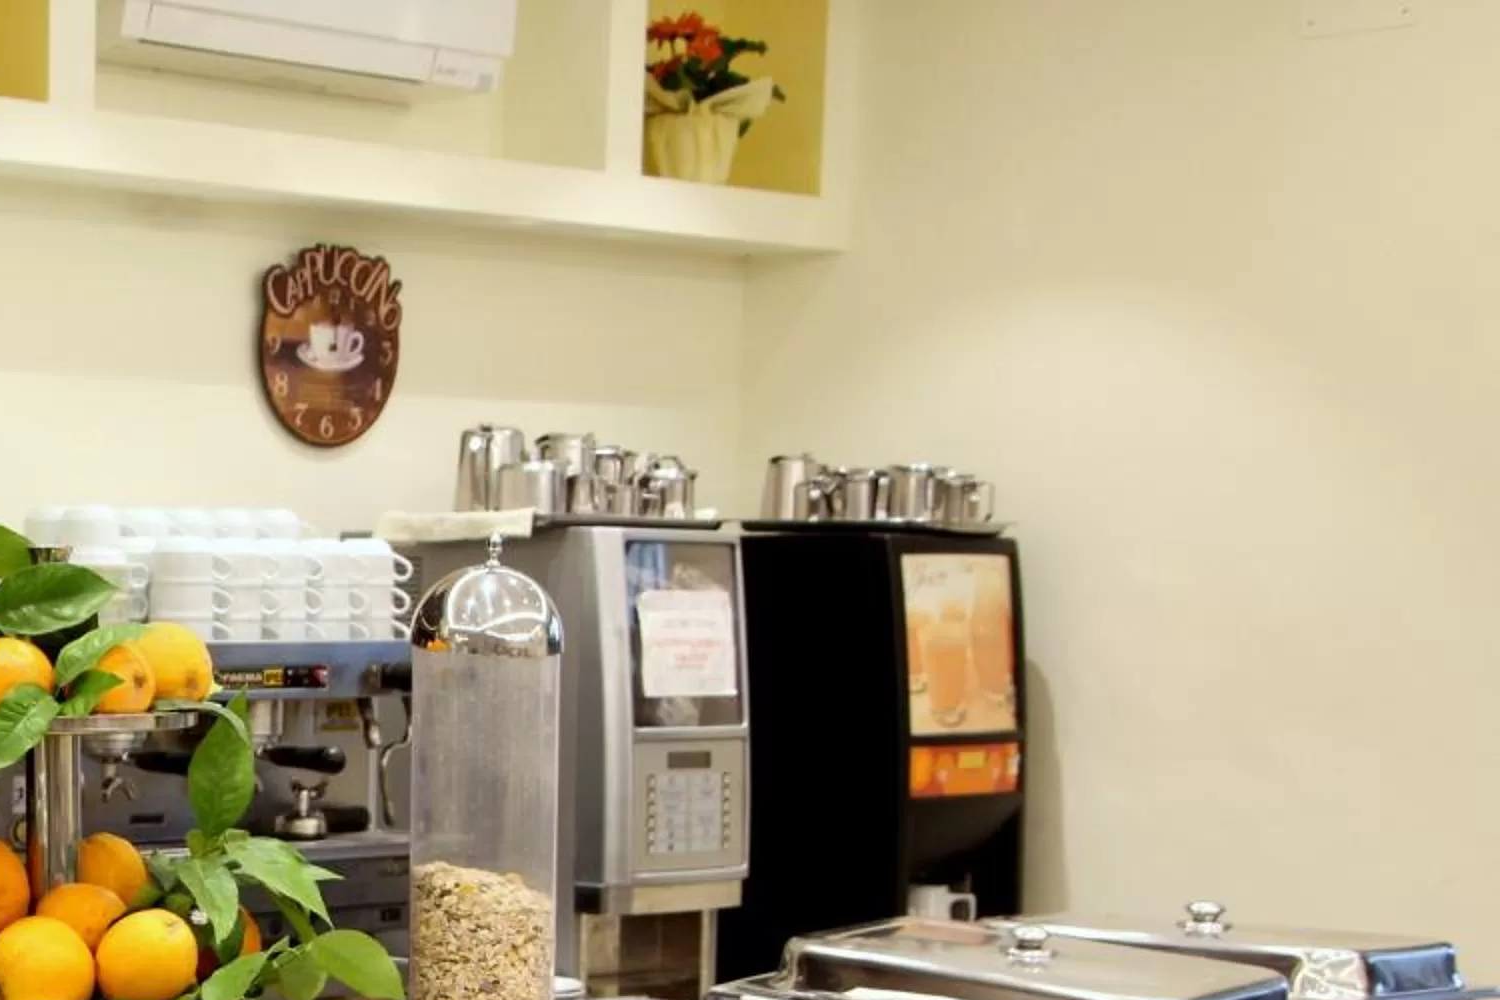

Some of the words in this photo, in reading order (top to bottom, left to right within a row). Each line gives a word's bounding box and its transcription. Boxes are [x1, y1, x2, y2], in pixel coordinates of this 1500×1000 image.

[380, 341, 394, 366] 3
[274, 372, 289, 397] 8
[293, 402, 309, 427] 7
[319, 415, 335, 439] 6
[349, 406, 363, 430] 5
